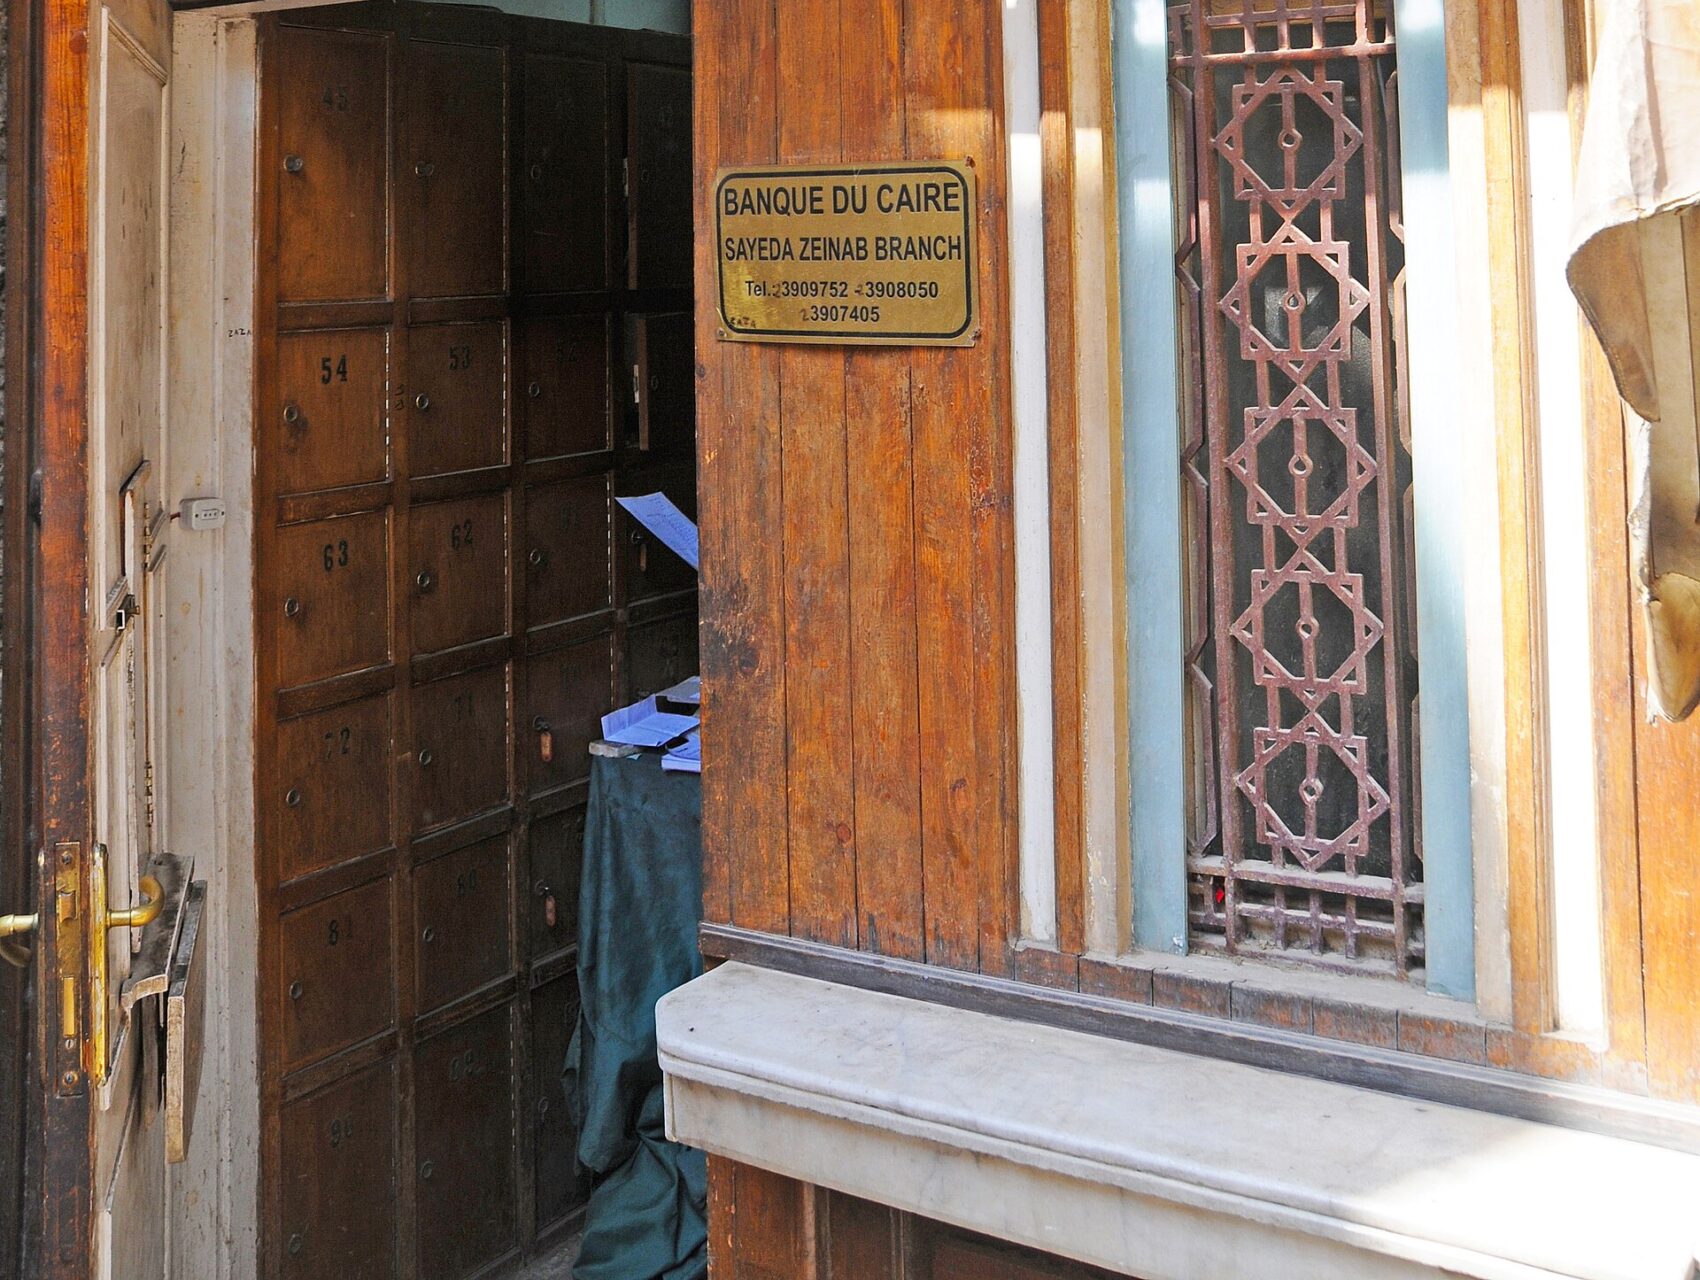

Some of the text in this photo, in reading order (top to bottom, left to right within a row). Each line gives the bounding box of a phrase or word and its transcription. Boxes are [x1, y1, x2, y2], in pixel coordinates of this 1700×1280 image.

[724, 182, 960, 216] BANQUE DU CAIRE
[725, 235, 961, 261] SAYEDA ZEINAB BRANCH
[321, 354, 348, 385] 54
[448, 344, 472, 370] 53
[450, 518, 474, 550] 62
[323, 540, 348, 572] 63
[328, 913, 353, 946] 81
